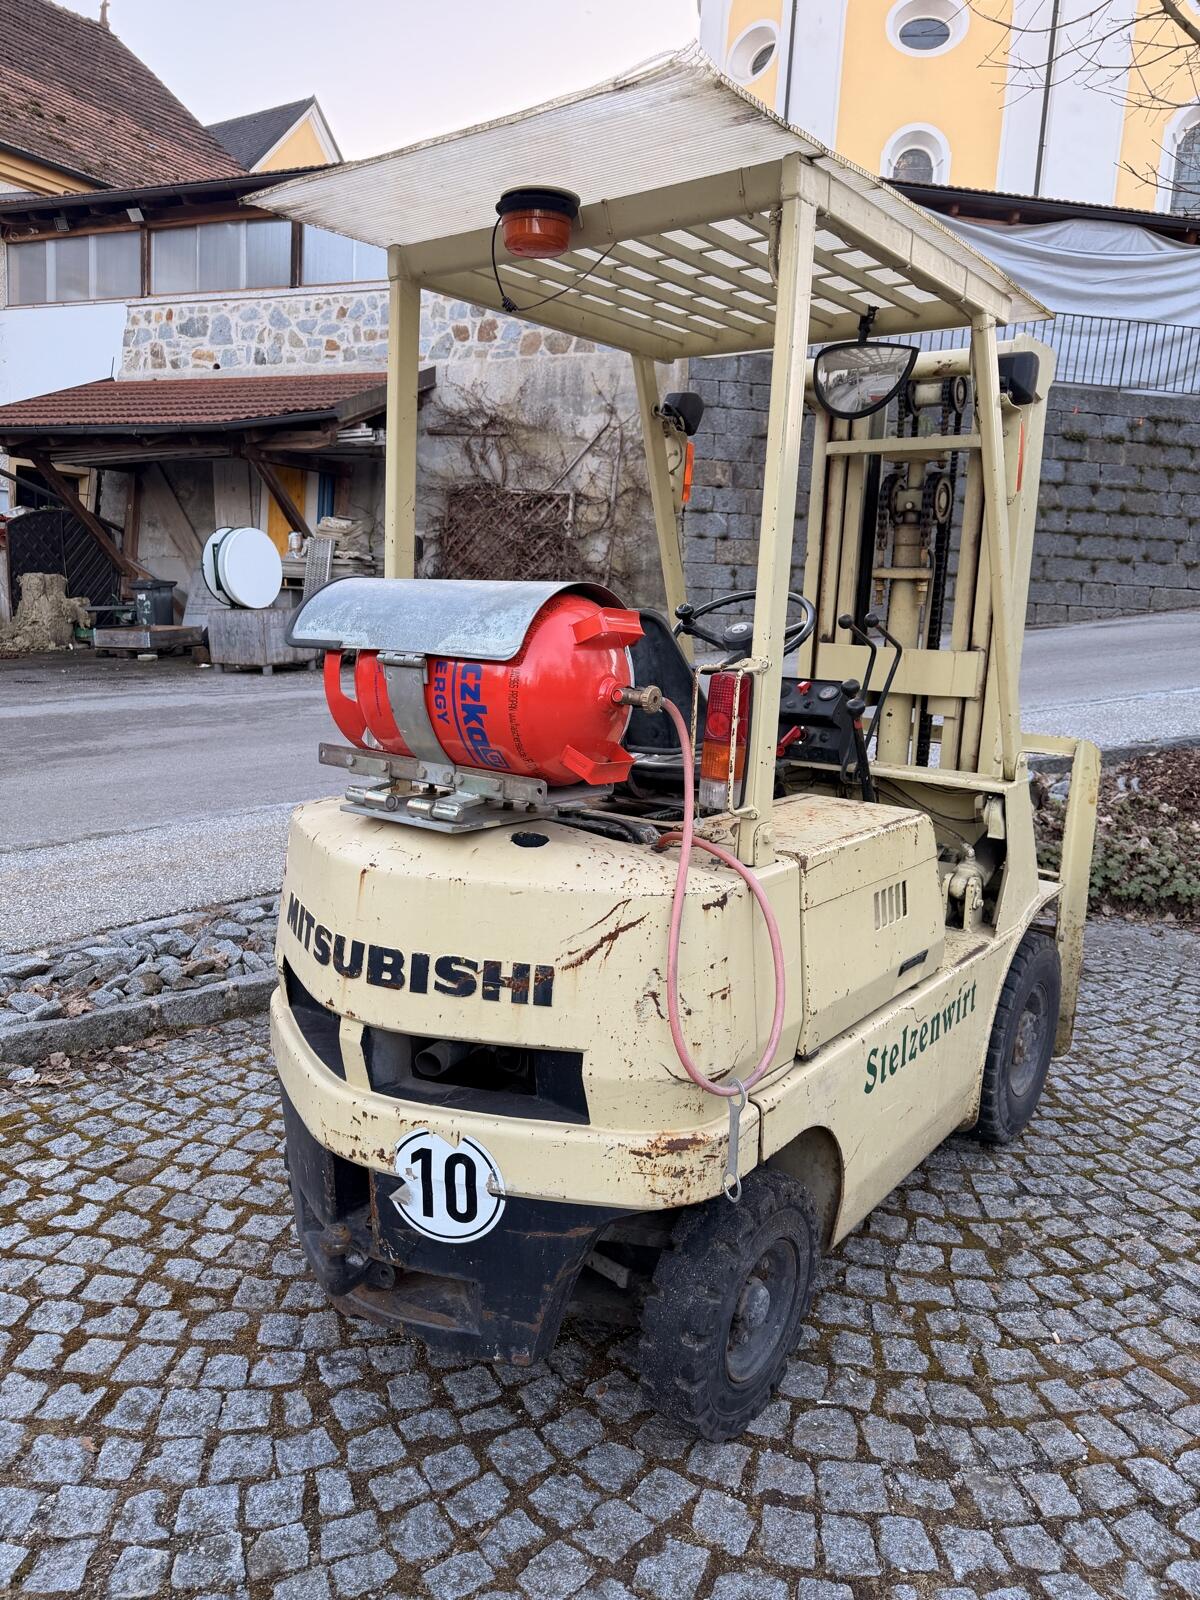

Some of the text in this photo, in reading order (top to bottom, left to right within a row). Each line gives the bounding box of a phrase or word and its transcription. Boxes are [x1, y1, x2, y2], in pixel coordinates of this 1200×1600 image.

[508, 690, 519, 711] PROPAN
[286, 891, 555, 1008] MITSUBISHI
[864, 979, 977, 1095] Stelzenwirt
[411, 1147, 478, 1224] 10
